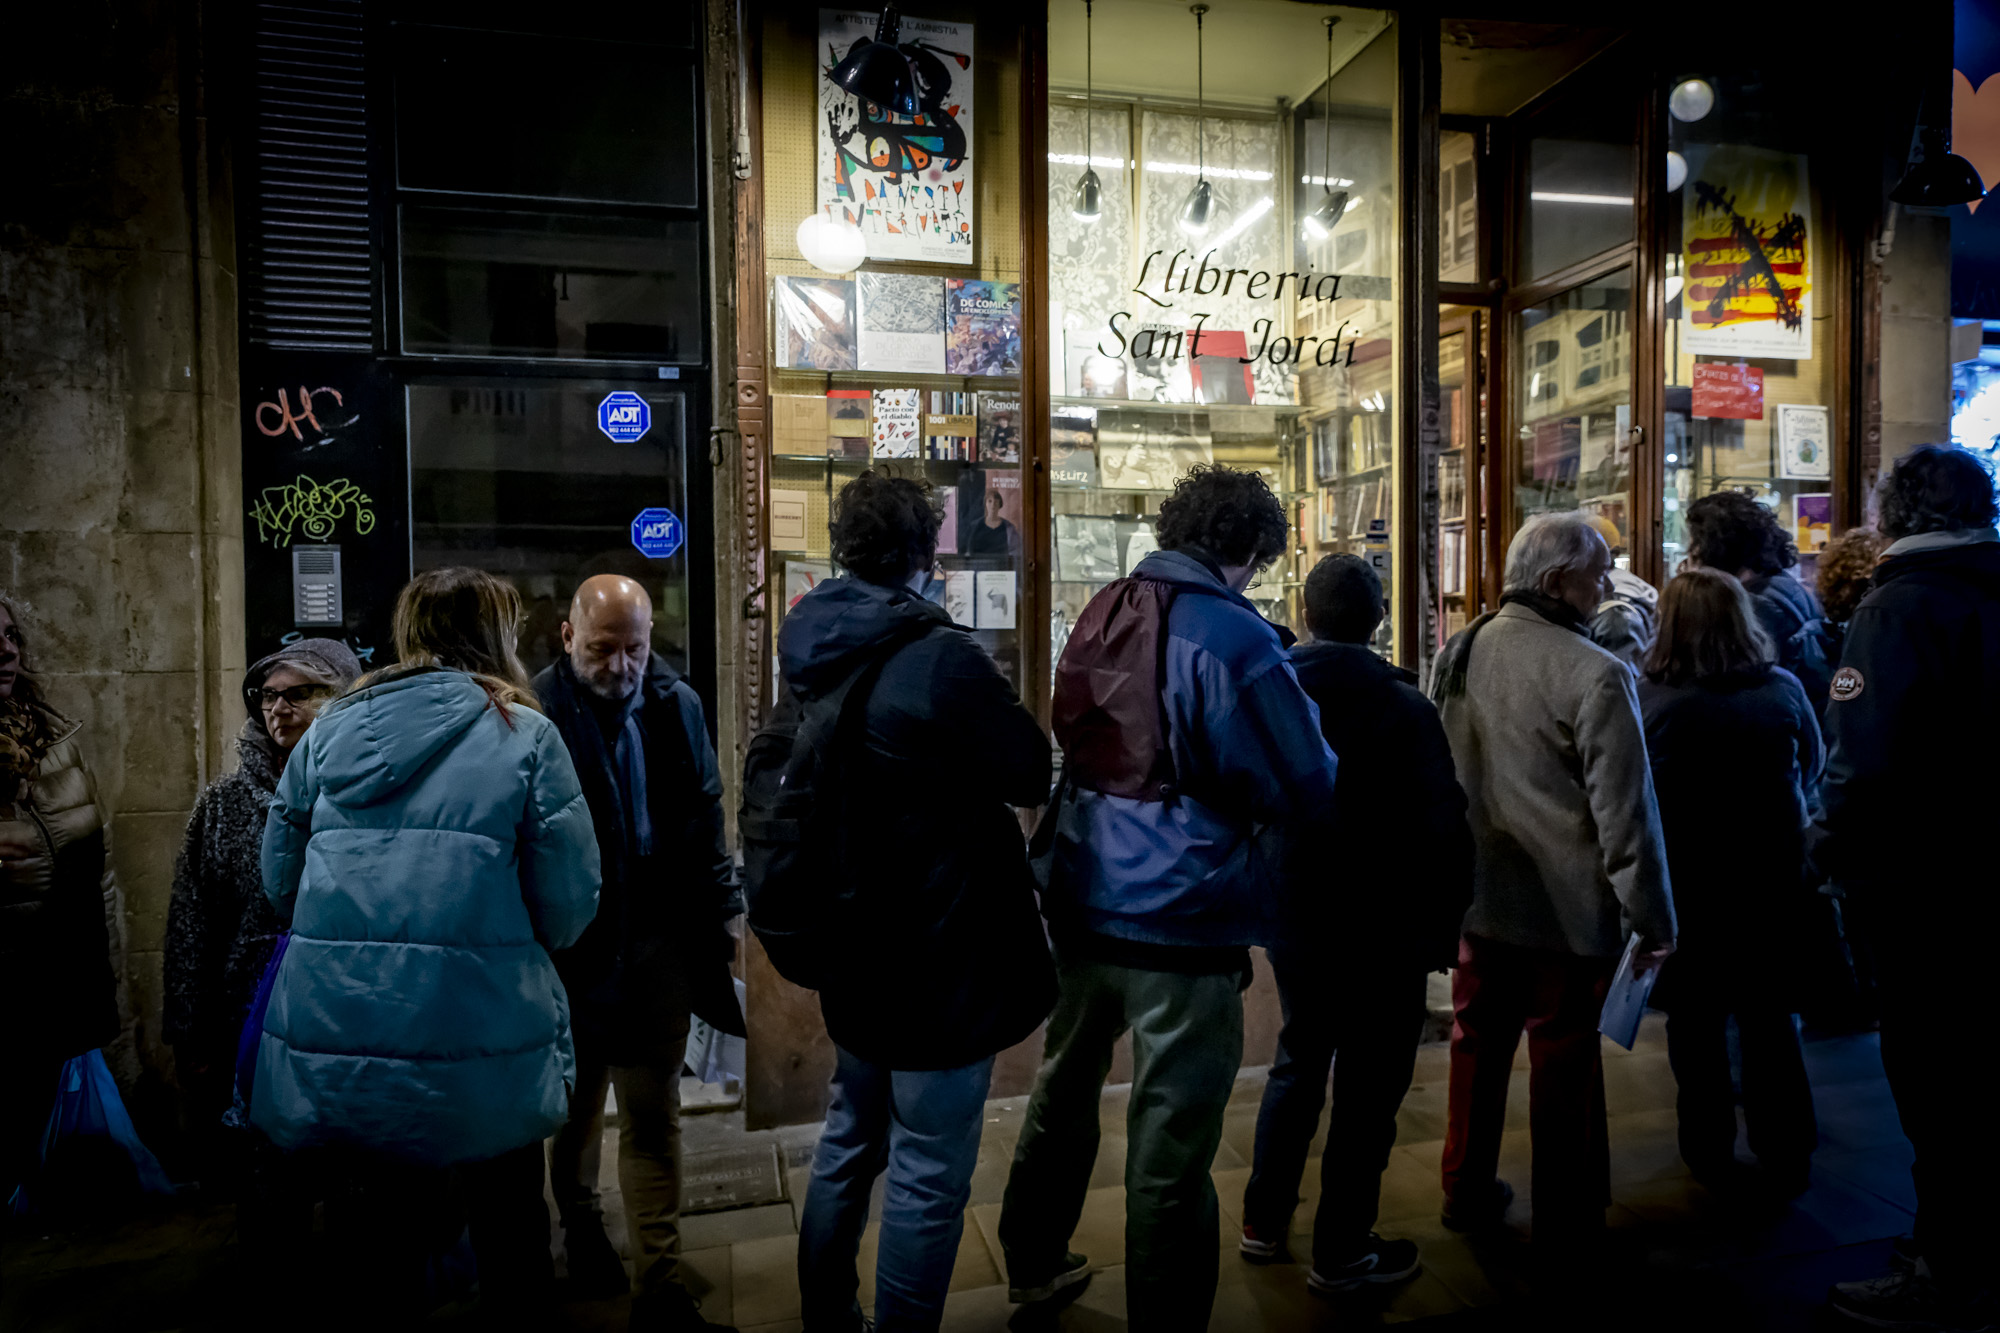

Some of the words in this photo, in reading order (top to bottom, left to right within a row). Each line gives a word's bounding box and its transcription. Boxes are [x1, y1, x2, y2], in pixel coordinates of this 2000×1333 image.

[834, 13, 880, 26] ARTISTES
[907, 20, 959, 36] L'AMNISTIA
[1133, 248, 1343, 308] Llibreria
[960, 298, 975, 308] DC
[976, 299, 1013, 311] COMICS
[1098, 311, 1211, 360] Sant
[1239, 318, 1360, 368] Jordi
[987, 398, 1020, 410] Renoir
[608, 405, 641, 424] ADT
[928, 416, 946, 424] 1001
[947, 416, 974, 425] LIBROS
[642, 520, 674, 539] ADT
